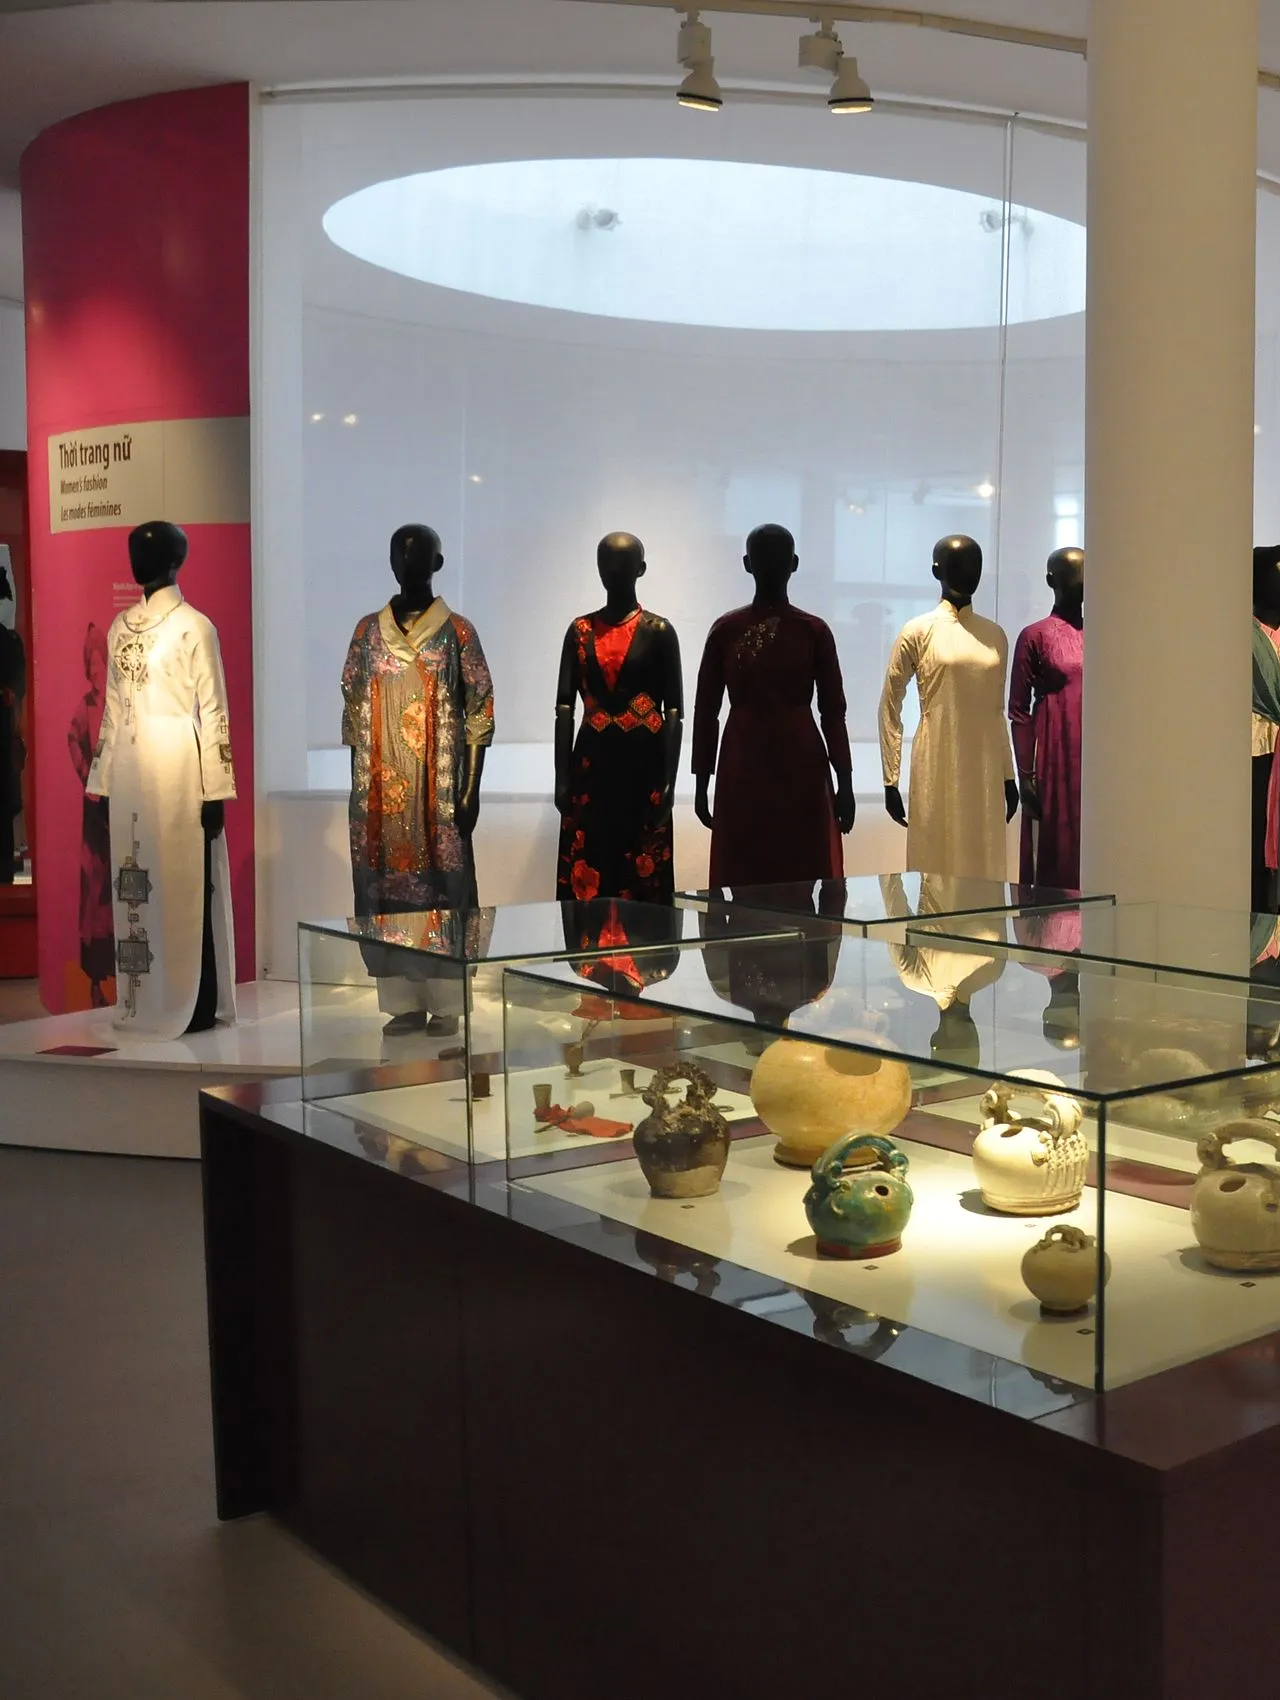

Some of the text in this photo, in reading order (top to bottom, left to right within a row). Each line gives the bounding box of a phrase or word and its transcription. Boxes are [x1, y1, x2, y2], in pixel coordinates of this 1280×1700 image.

[59, 434, 132, 470] Thời trang nữ
[83, 473, 108, 492] fashion
[61, 500, 122, 522] Les modes féminines
